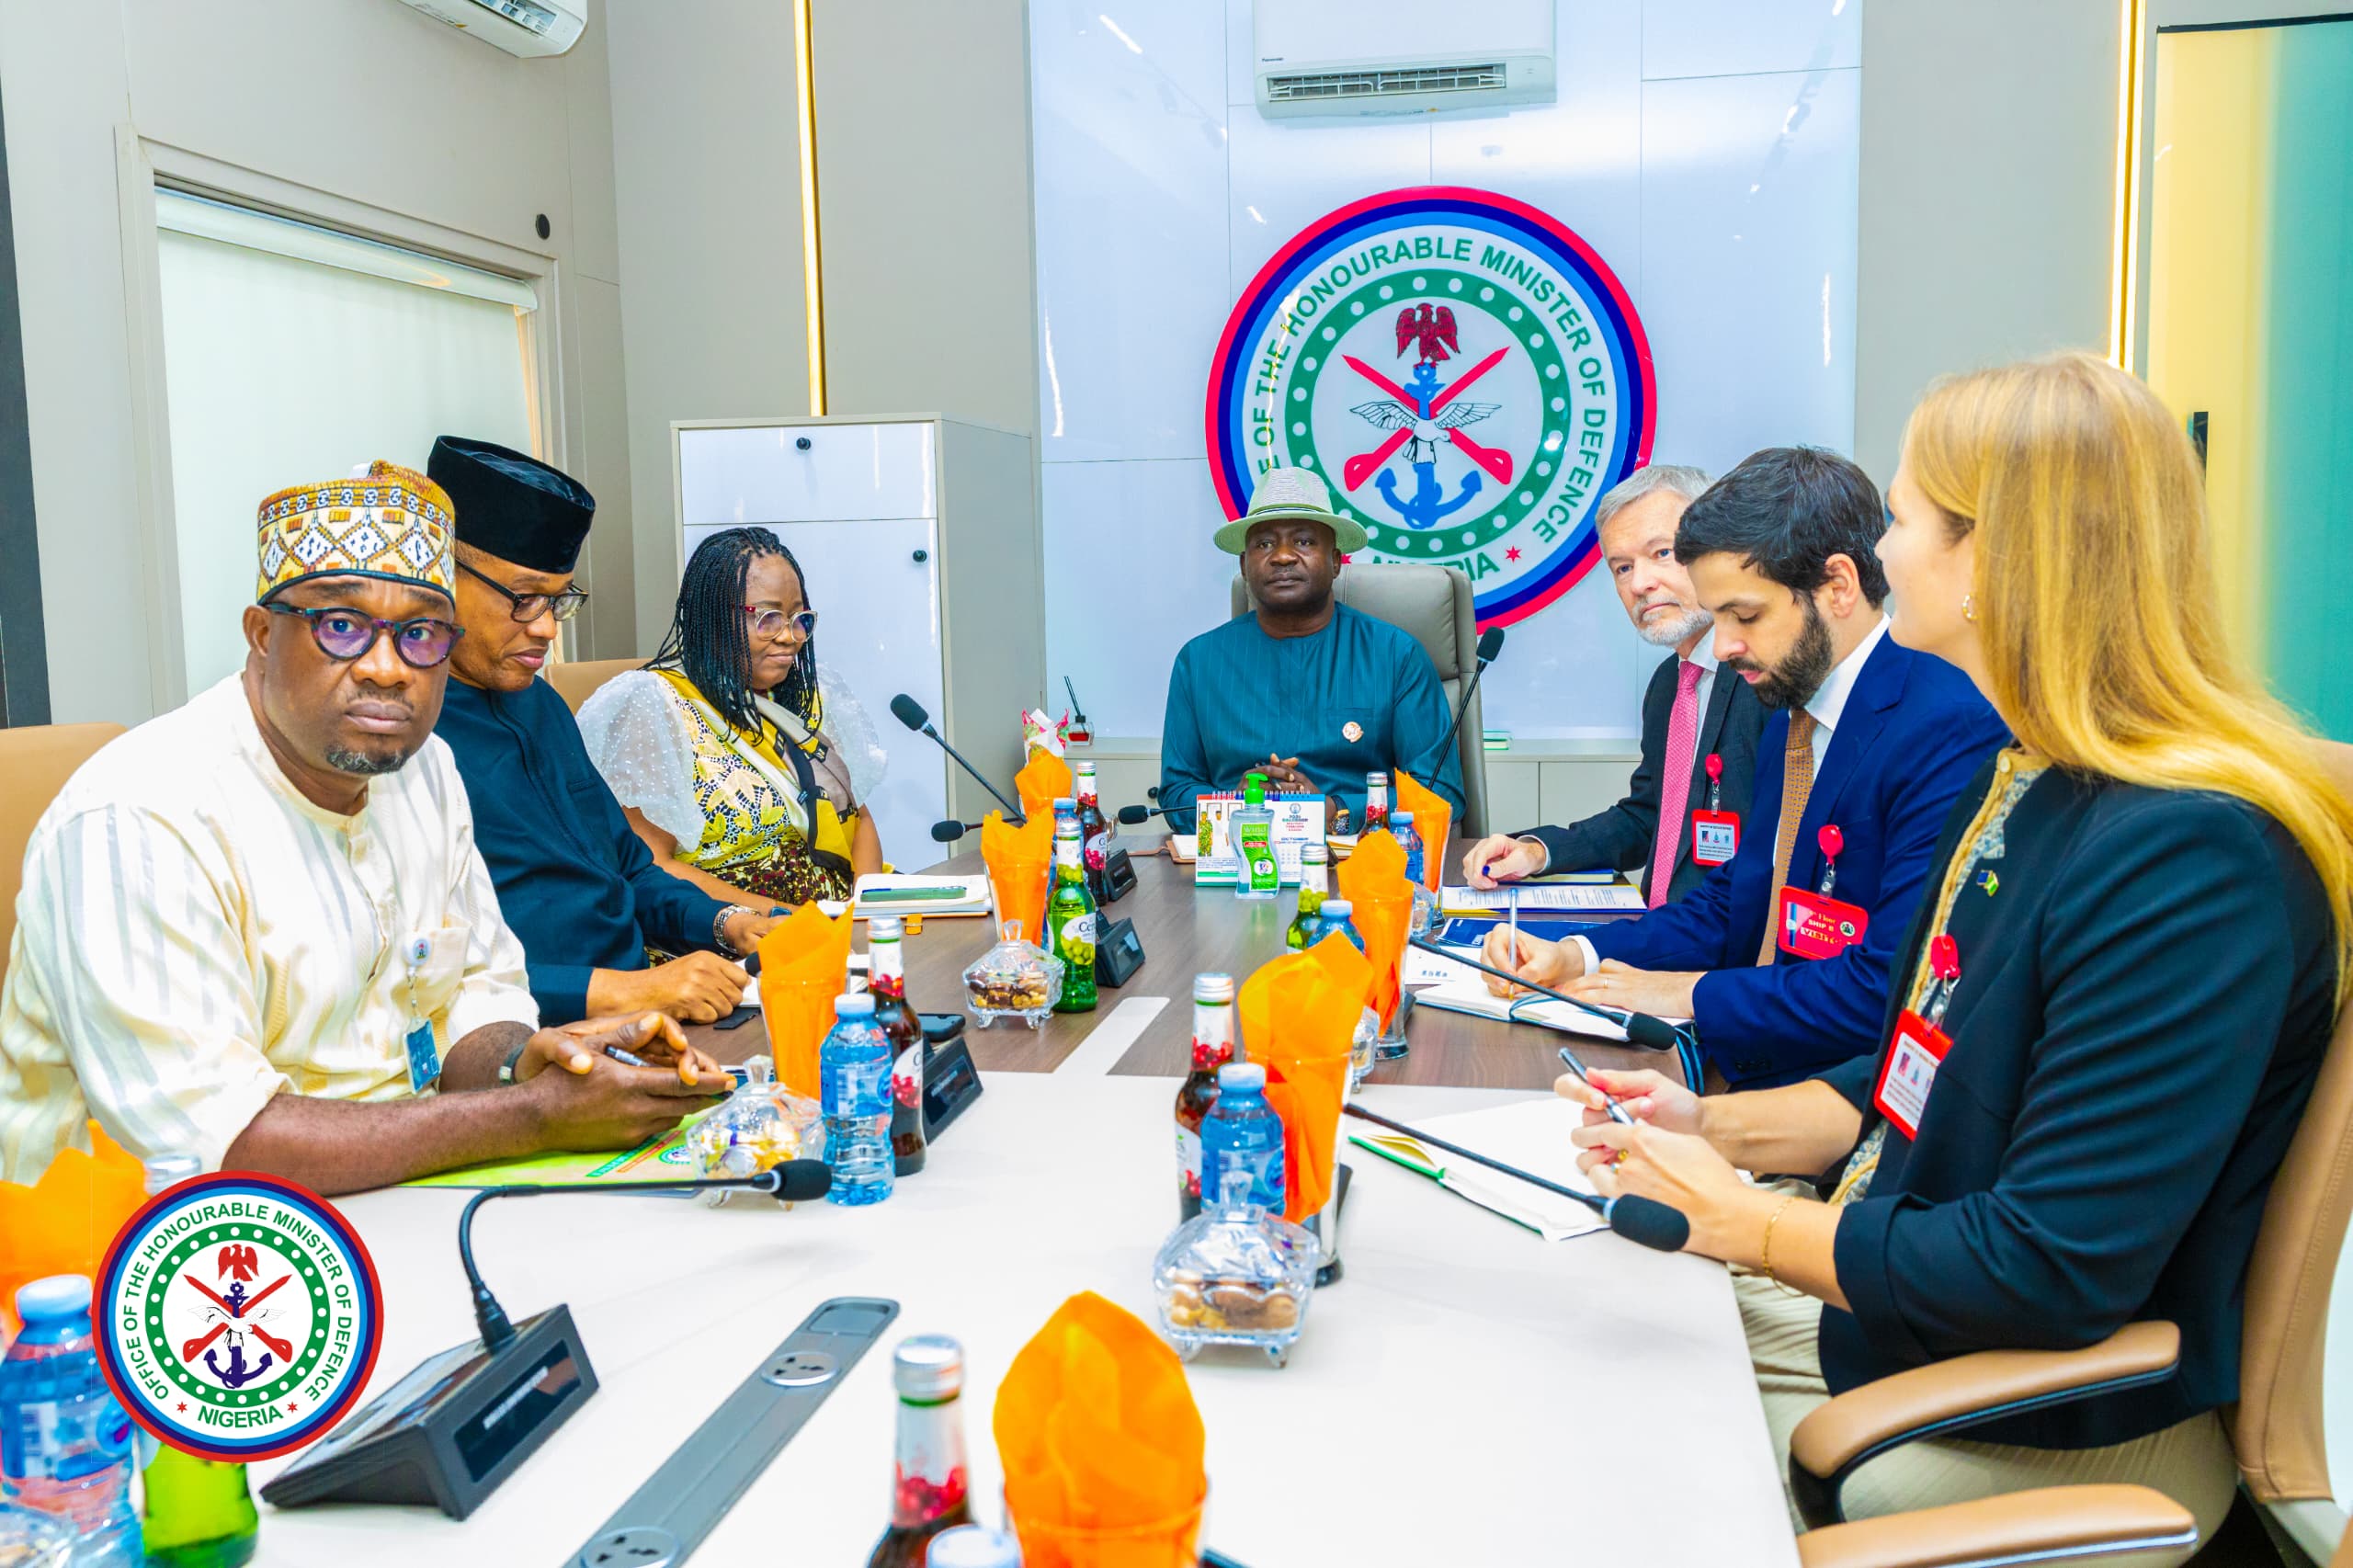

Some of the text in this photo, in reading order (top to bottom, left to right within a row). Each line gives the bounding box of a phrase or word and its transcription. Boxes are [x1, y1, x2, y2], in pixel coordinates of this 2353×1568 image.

[1253, 236, 1607, 542] OF THE HONOURABLE MINISTER OF DEFENCE
